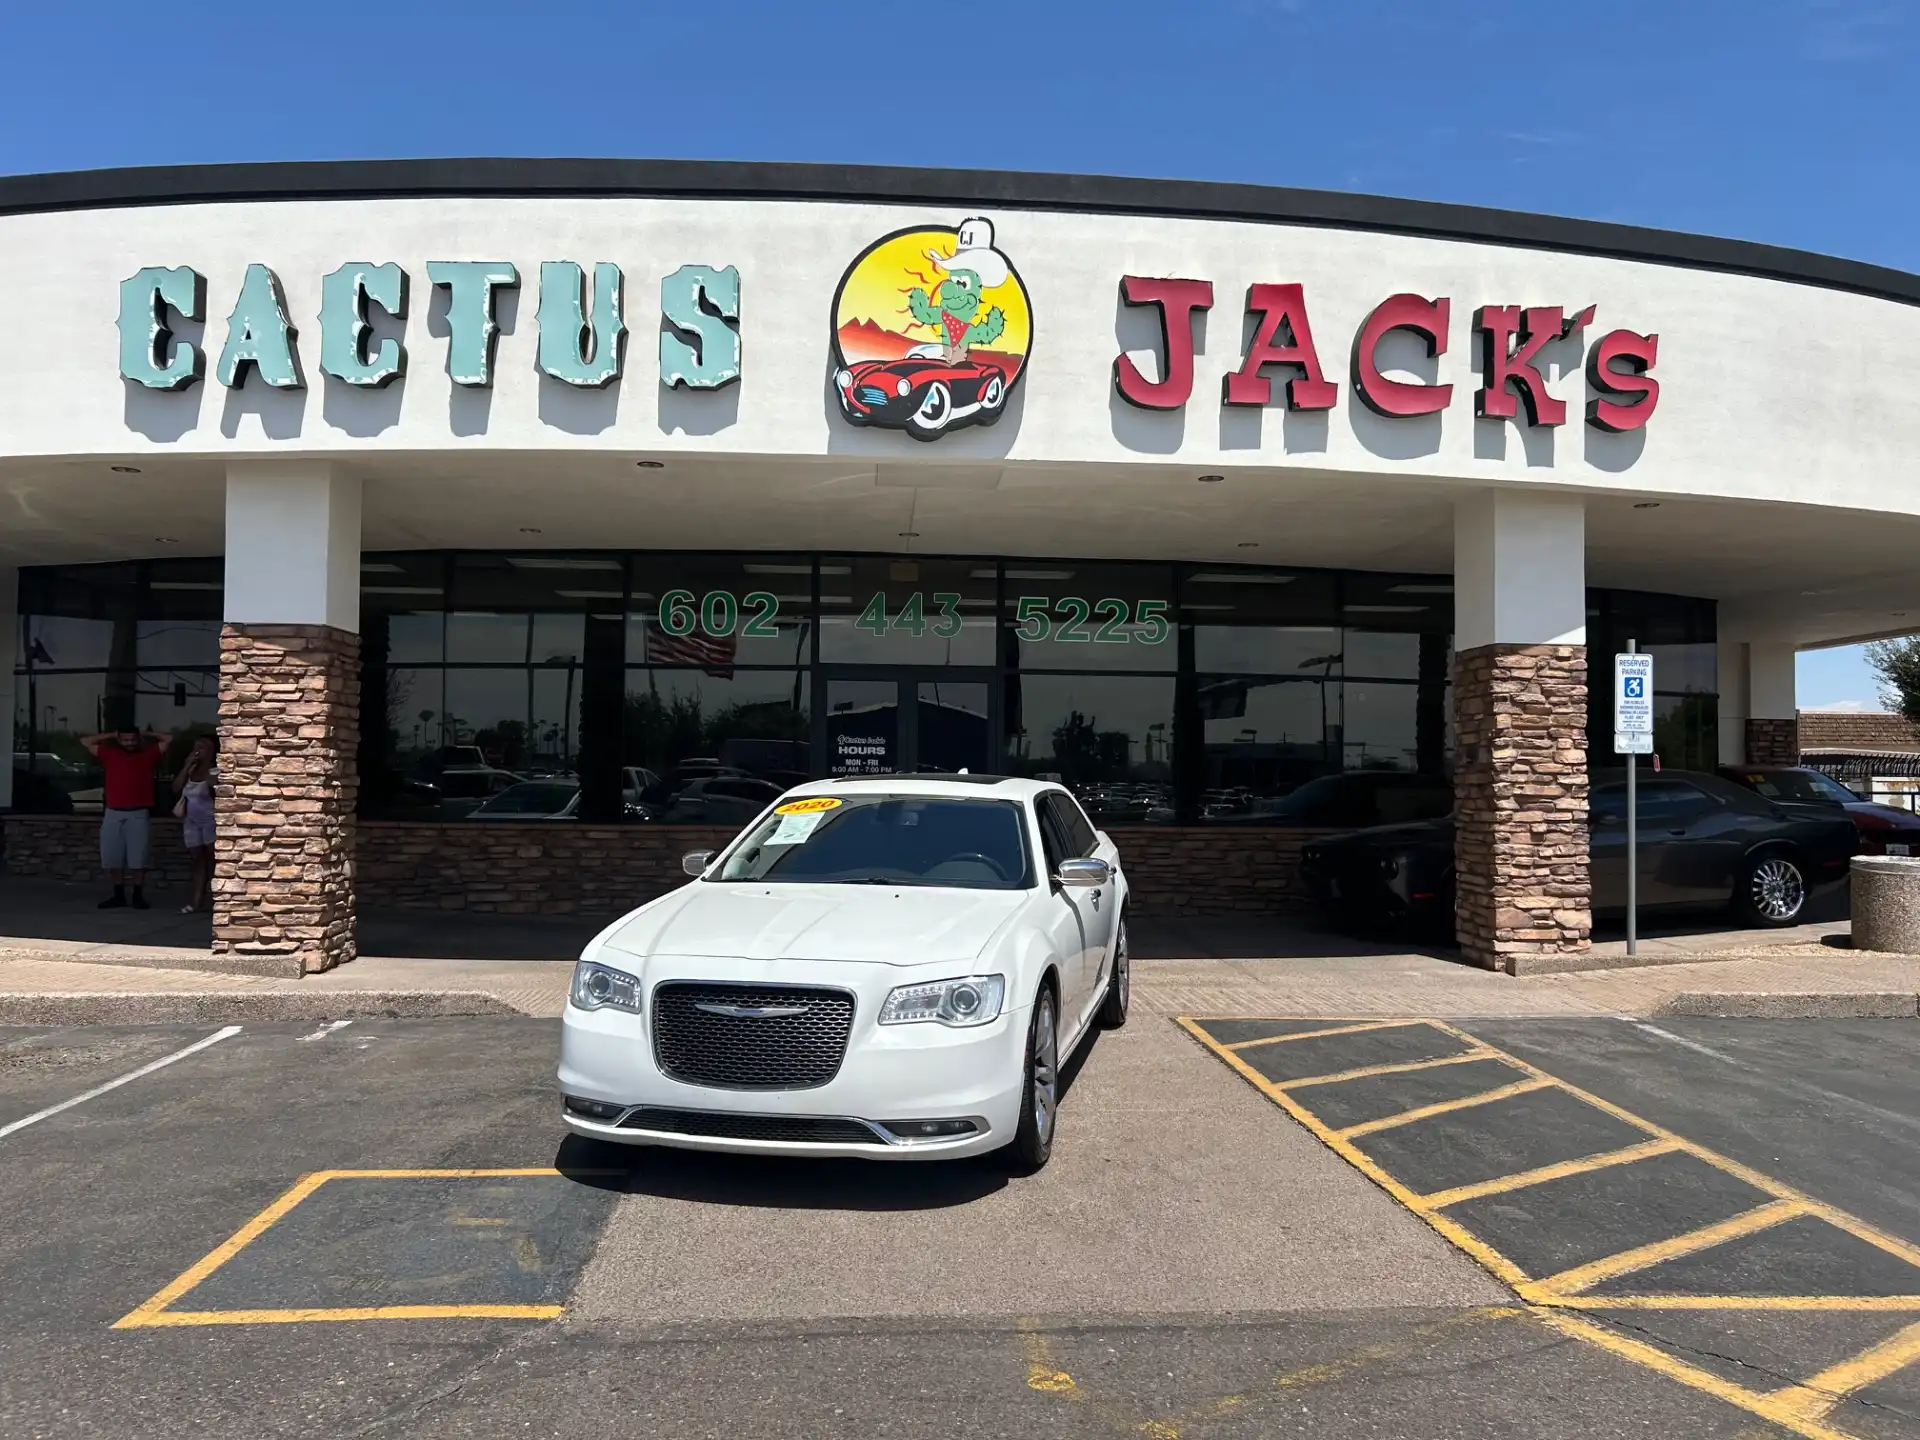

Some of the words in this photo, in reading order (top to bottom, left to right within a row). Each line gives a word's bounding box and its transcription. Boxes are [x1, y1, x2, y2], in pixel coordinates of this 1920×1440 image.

[959, 229, 974, 246] CJ
[115, 261, 741, 391] CACTUS
[658, 589, 779, 638] 602
[854, 591, 963, 638] 443
[1014, 595, 1169, 644] 5225
[1621, 668, 1647, 676] PARKING
[838, 746, 886, 755] HOURS
[845, 758, 861, 766] MON
[783, 800, 835, 812] 2020
